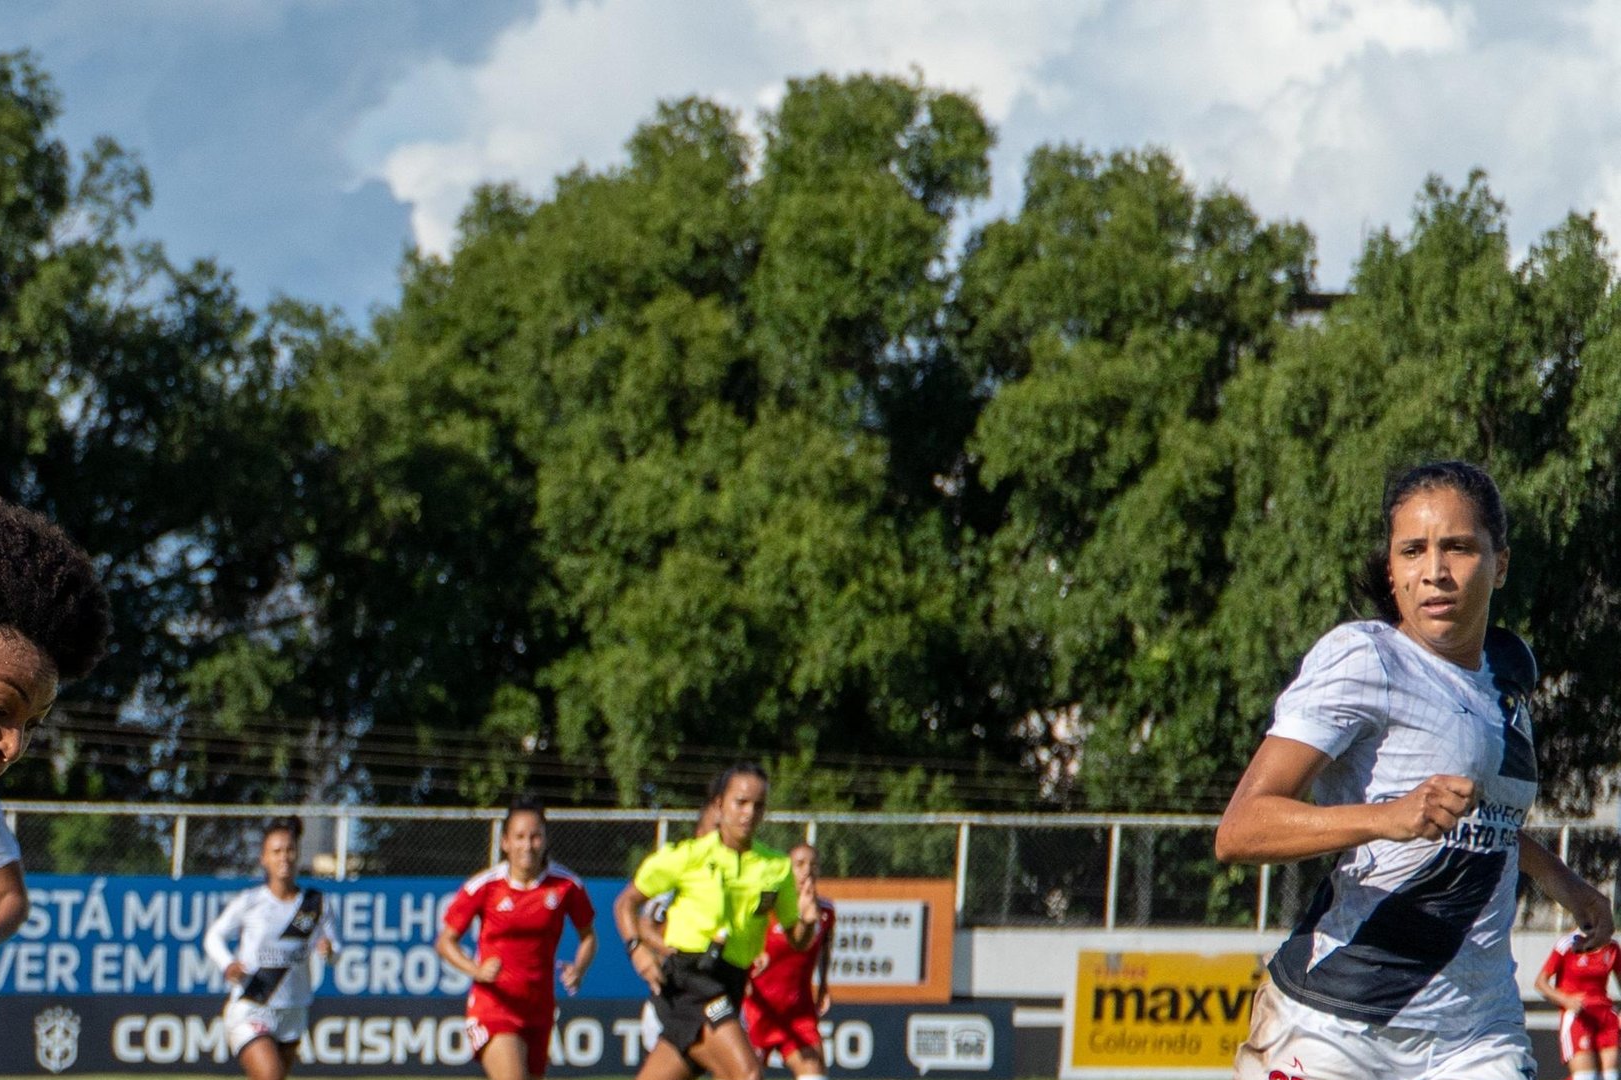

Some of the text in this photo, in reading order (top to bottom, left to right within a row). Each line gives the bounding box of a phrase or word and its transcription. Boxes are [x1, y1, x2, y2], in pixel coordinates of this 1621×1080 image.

[17, 876, 113, 940] STÁ
[123, 890, 246, 941] MUI
[91, 941, 167, 993] EM
[334, 944, 474, 995] GROS
[838, 933, 874, 951] ato
[112, 1015, 229, 1063] COM
[297, 1015, 474, 1065] CISMO
